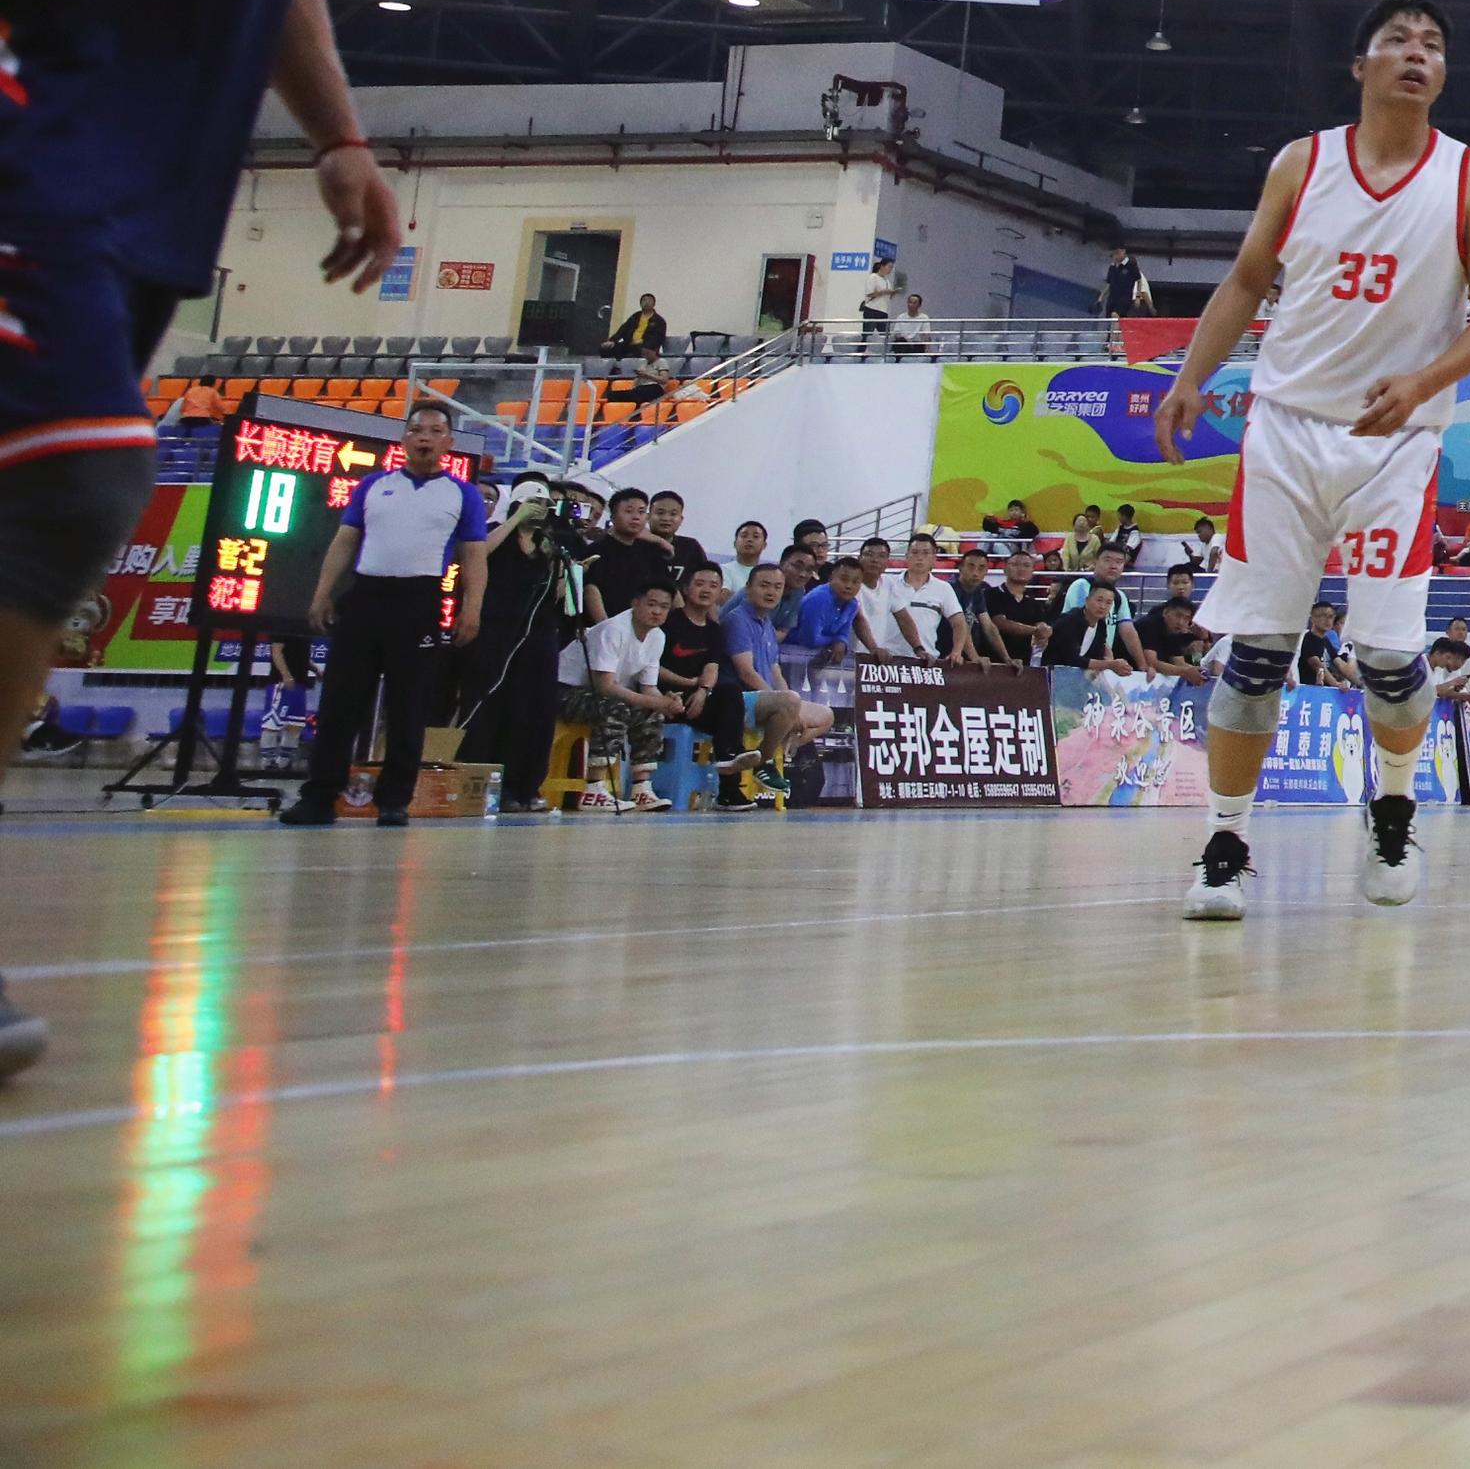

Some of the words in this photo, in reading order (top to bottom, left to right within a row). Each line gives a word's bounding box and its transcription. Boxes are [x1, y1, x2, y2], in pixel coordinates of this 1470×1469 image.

[1332, 252, 1398, 303] 33
[235, 420, 340, 475] 长顺教育
[244, 470, 298, 534] 18
[1343, 529, 1398, 578] 33
[864, 700, 1048, 776] 志邦全屋定制
[1082, 692, 1196, 742] 神泉谷景区
